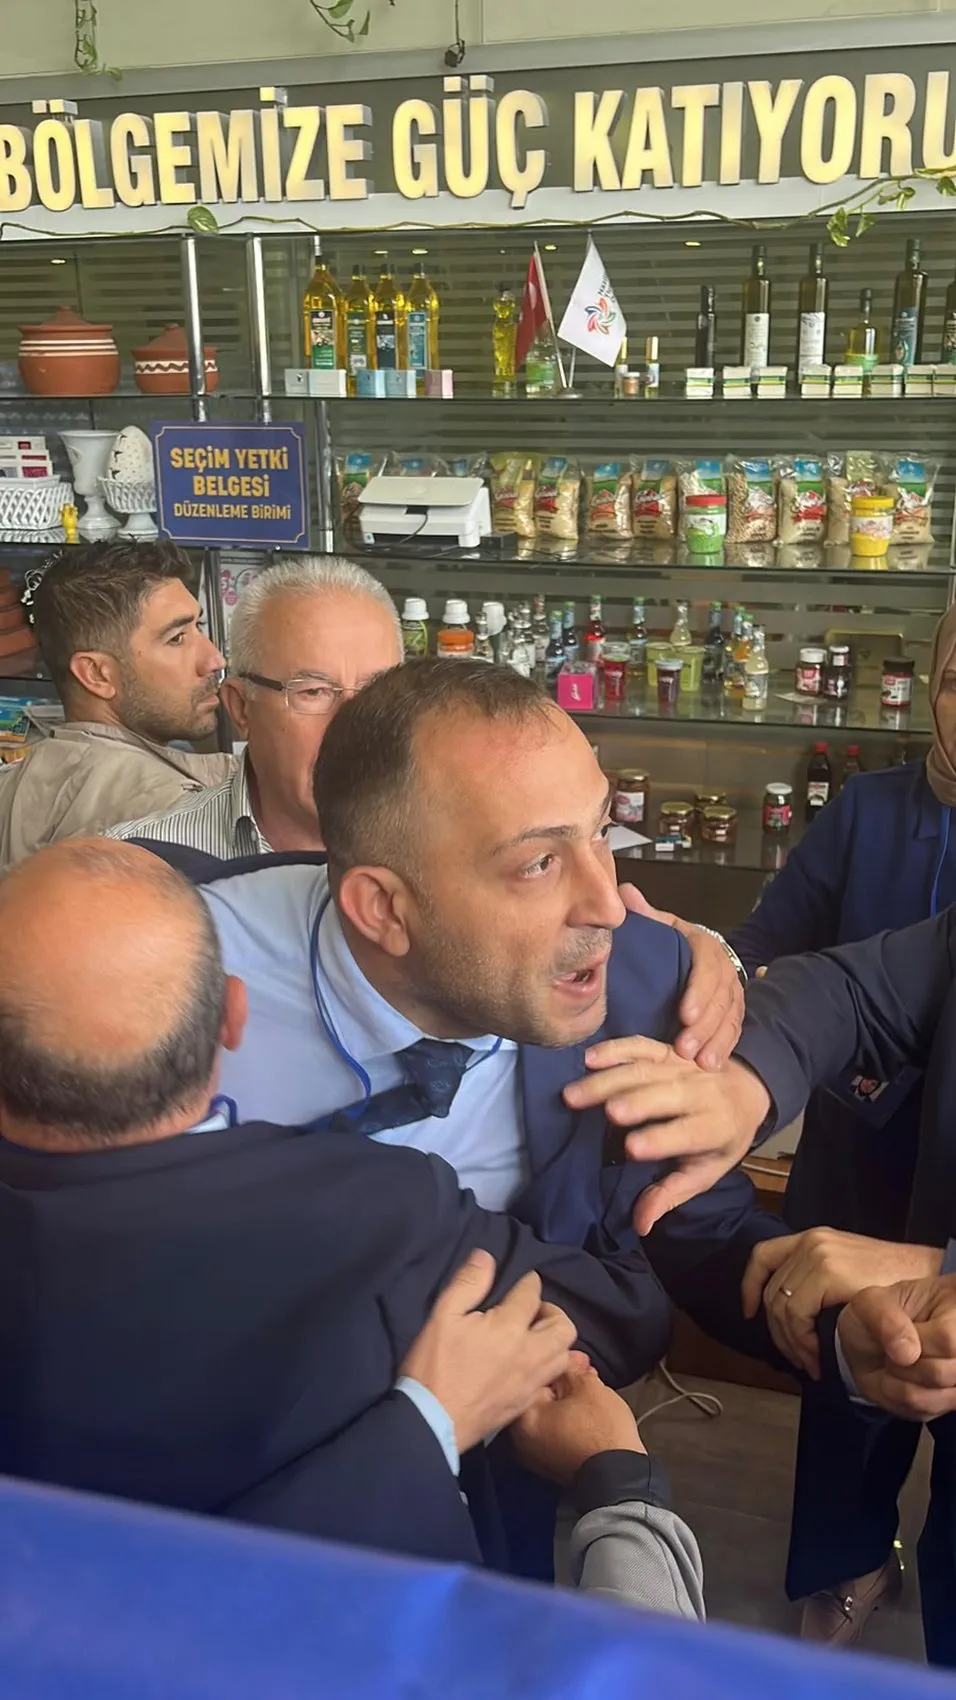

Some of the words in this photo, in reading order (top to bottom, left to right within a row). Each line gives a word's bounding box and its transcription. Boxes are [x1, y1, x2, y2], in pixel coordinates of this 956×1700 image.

[0, 86, 372, 212] BÖLGEMİZE
[392, 74, 549, 208] GÜÇ
[573, 70, 956, 191] KATIYORU
[170, 445, 231, 472] SEÇİM
[235, 446, 288, 470] YETKİ
[193, 474, 270, 497] BELGESİ
[174, 500, 249, 518] DÜZENLEME
[251, 503, 291, 520] BİRİMİ
